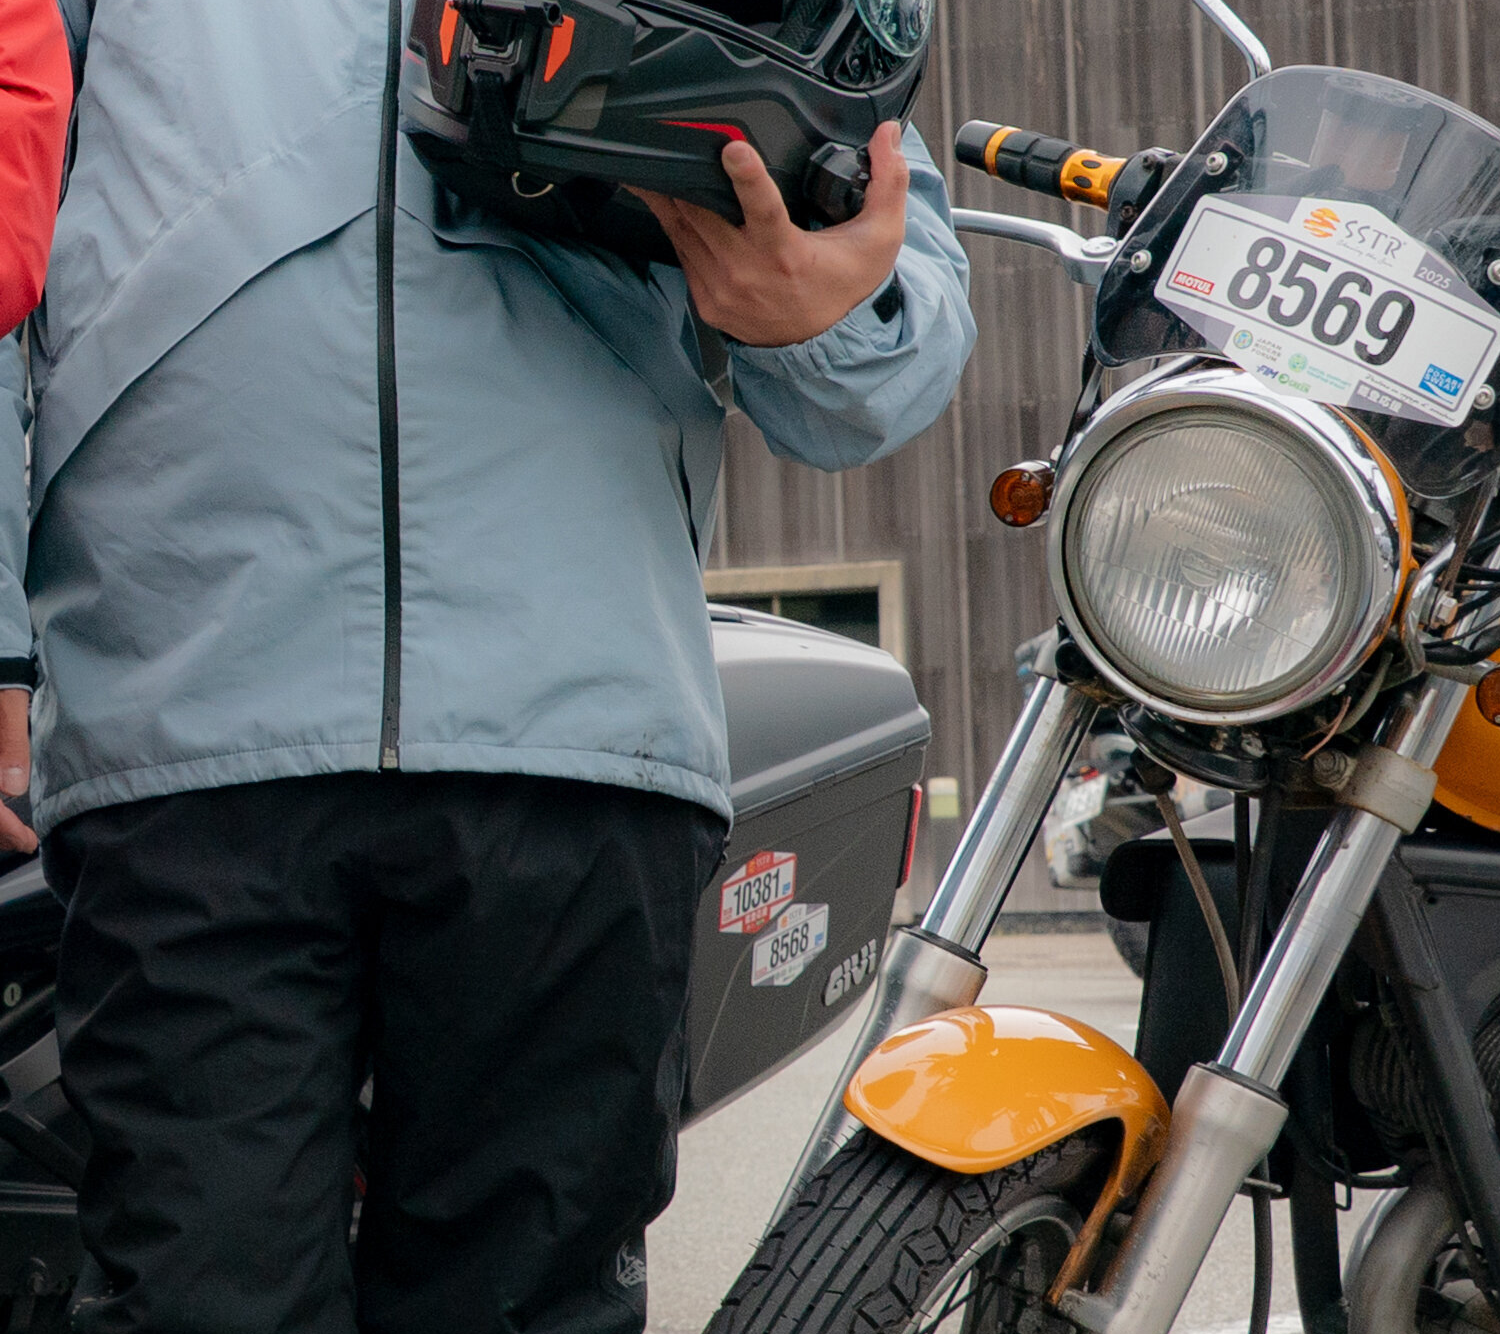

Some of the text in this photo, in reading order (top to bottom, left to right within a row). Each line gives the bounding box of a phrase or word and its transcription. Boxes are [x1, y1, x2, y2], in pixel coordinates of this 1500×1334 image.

[1344, 219, 1403, 260] SSTR
[1175, 273, 1214, 294] MOTUL
[1416, 267, 1452, 290] 2025
[1226, 236, 1416, 366] 8569
[1424, 373, 1456, 393] SWEAT
[1426, 367, 1464, 389] POCARI
[733, 867, 780, 916] 10381
[770, 922, 810, 968] 8568
[823, 938, 877, 1007] GIVI
